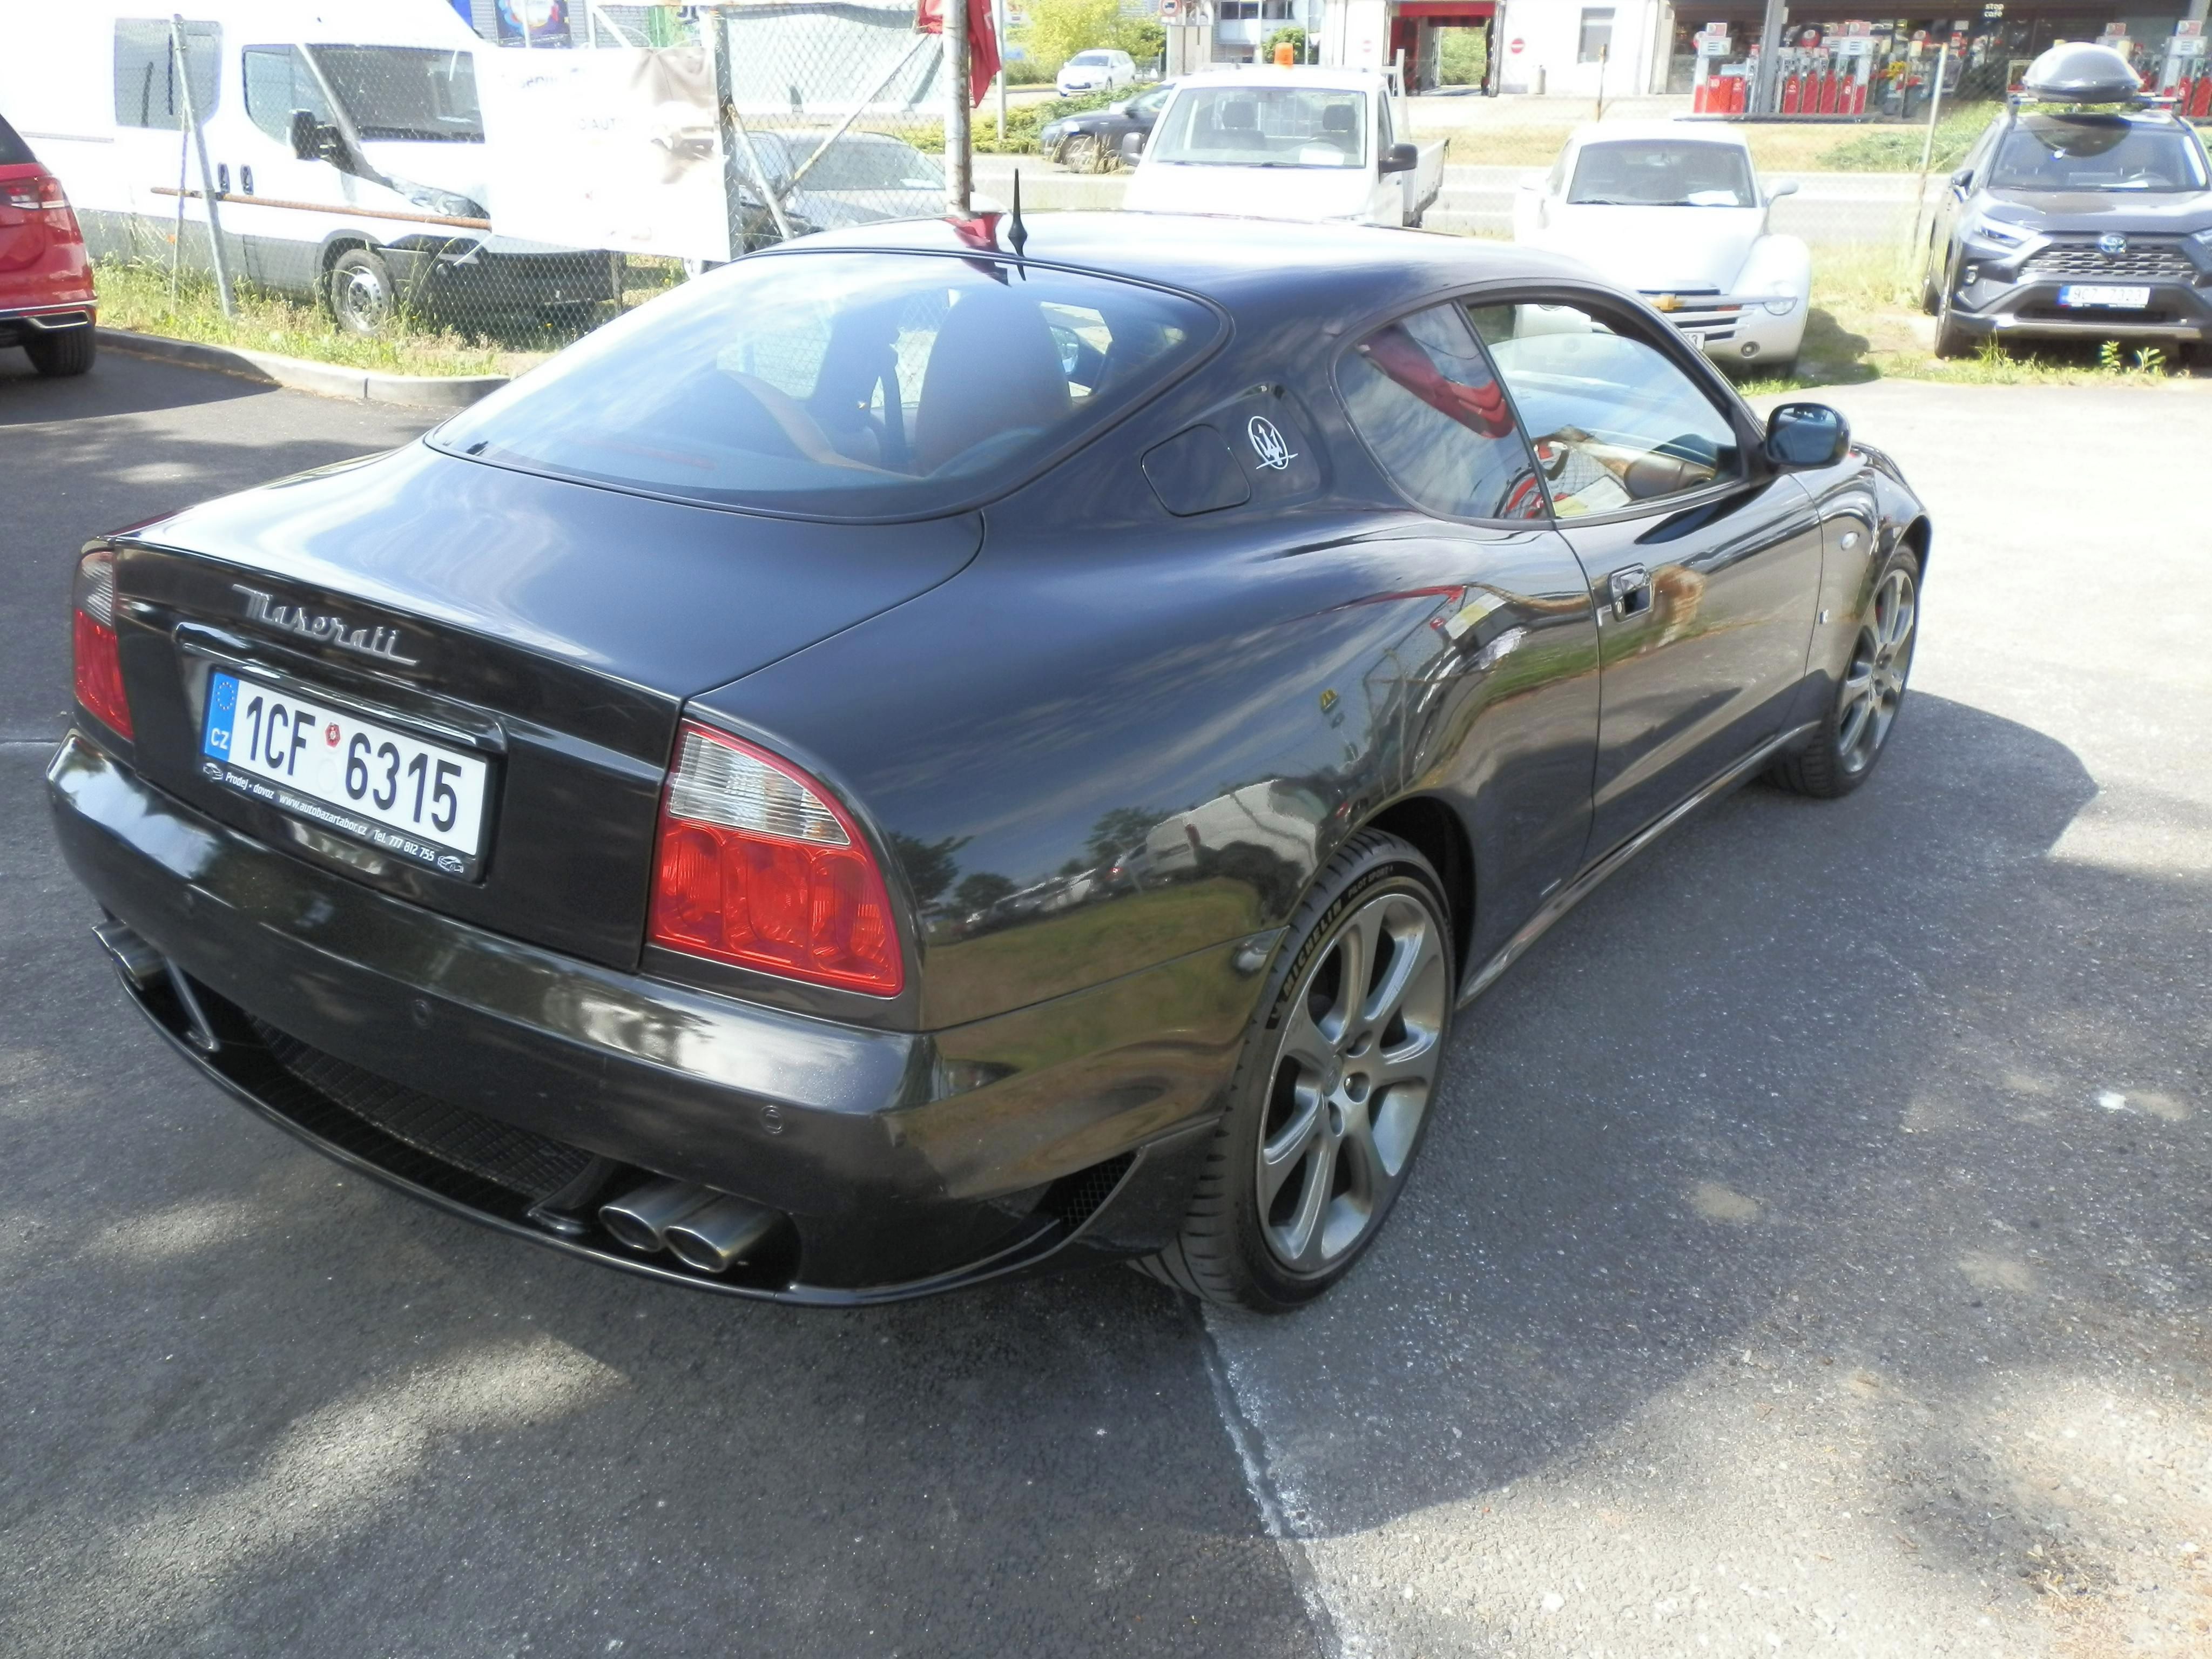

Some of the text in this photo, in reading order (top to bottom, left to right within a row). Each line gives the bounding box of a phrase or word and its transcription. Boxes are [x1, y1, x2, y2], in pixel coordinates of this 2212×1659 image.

[232, 584, 421, 666] Maserati
[211, 696, 462, 832] CZ 1CF 6315
[225, 772, 435, 862] Prodej dovoz www.autobazartabor.cz Tel. 777 812 755
[1283, 898, 1342, 997] MICHELIN
